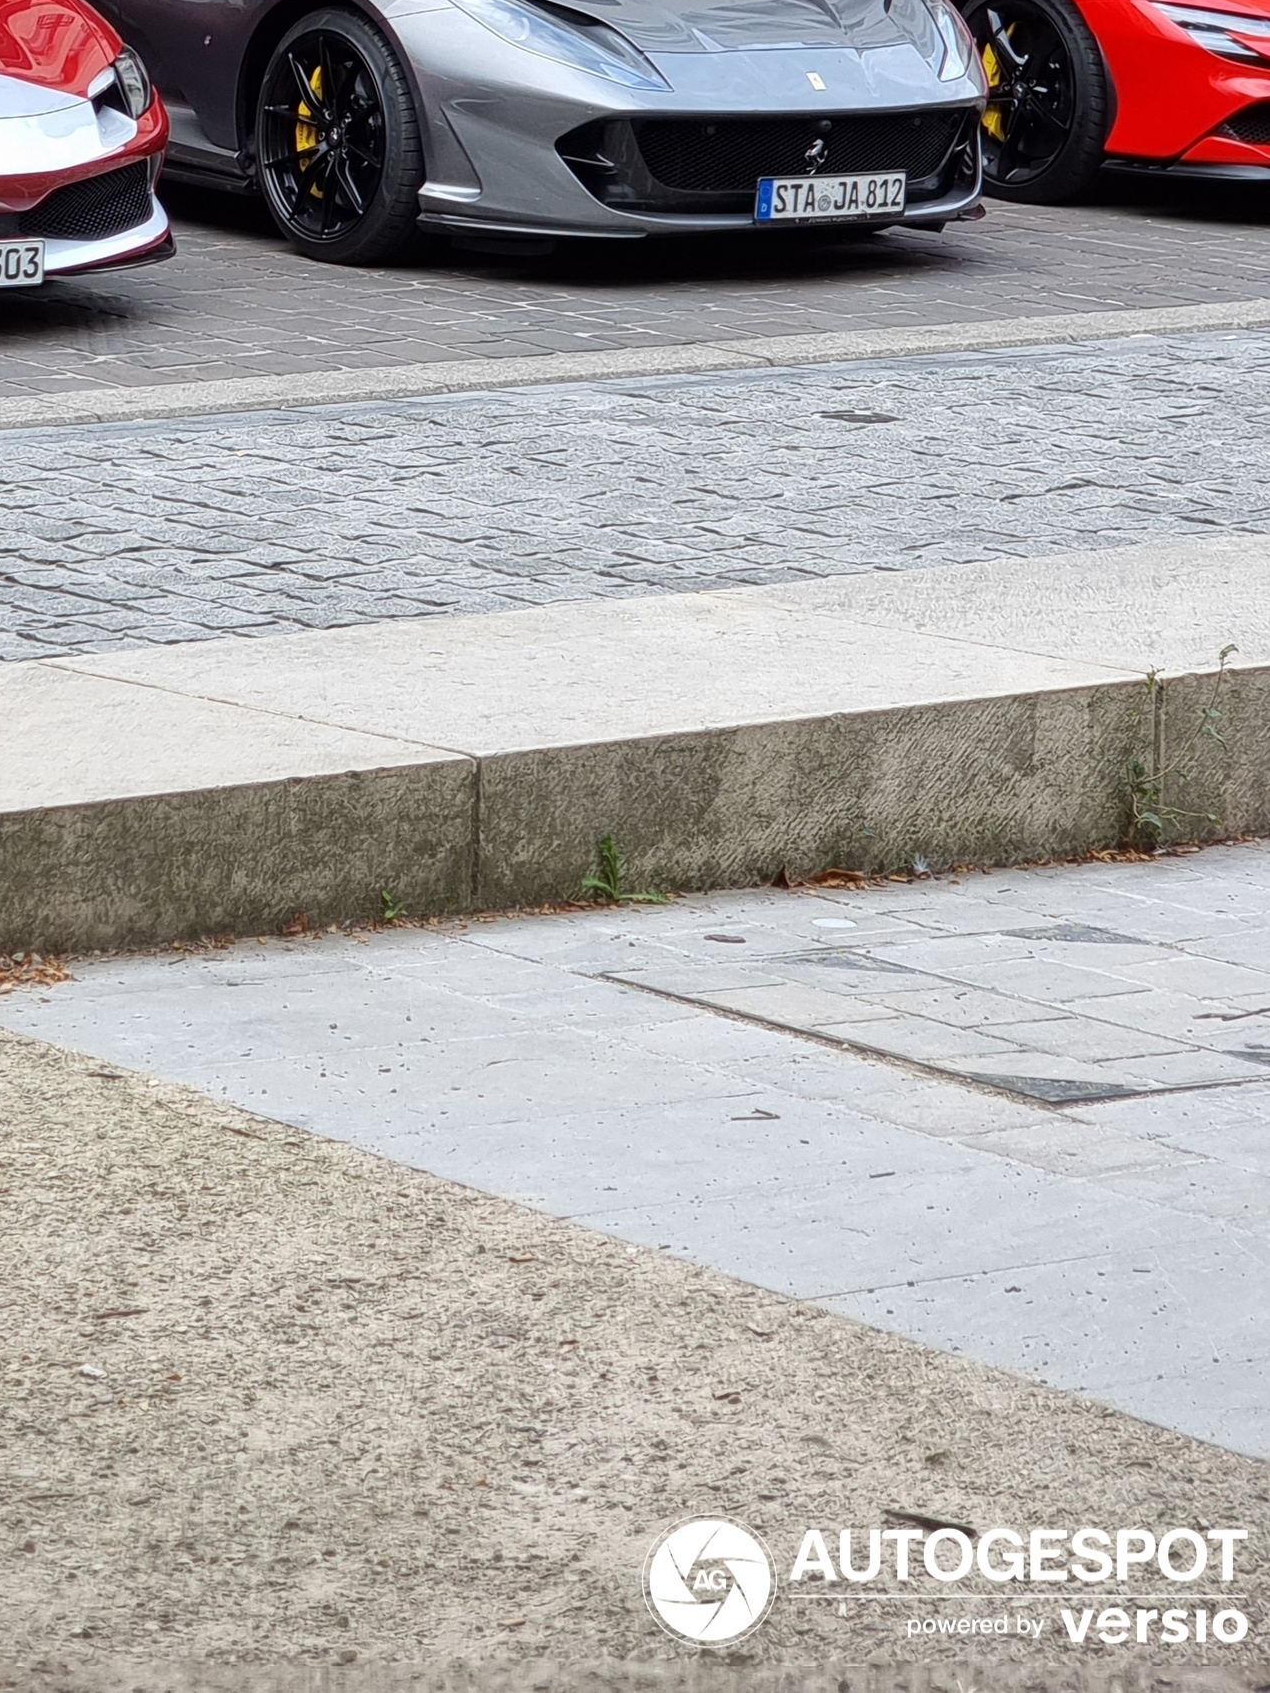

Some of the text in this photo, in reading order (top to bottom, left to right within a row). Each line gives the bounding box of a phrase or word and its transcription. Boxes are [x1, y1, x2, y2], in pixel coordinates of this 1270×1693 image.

[761, 178, 903, 213] D STA JA 812
